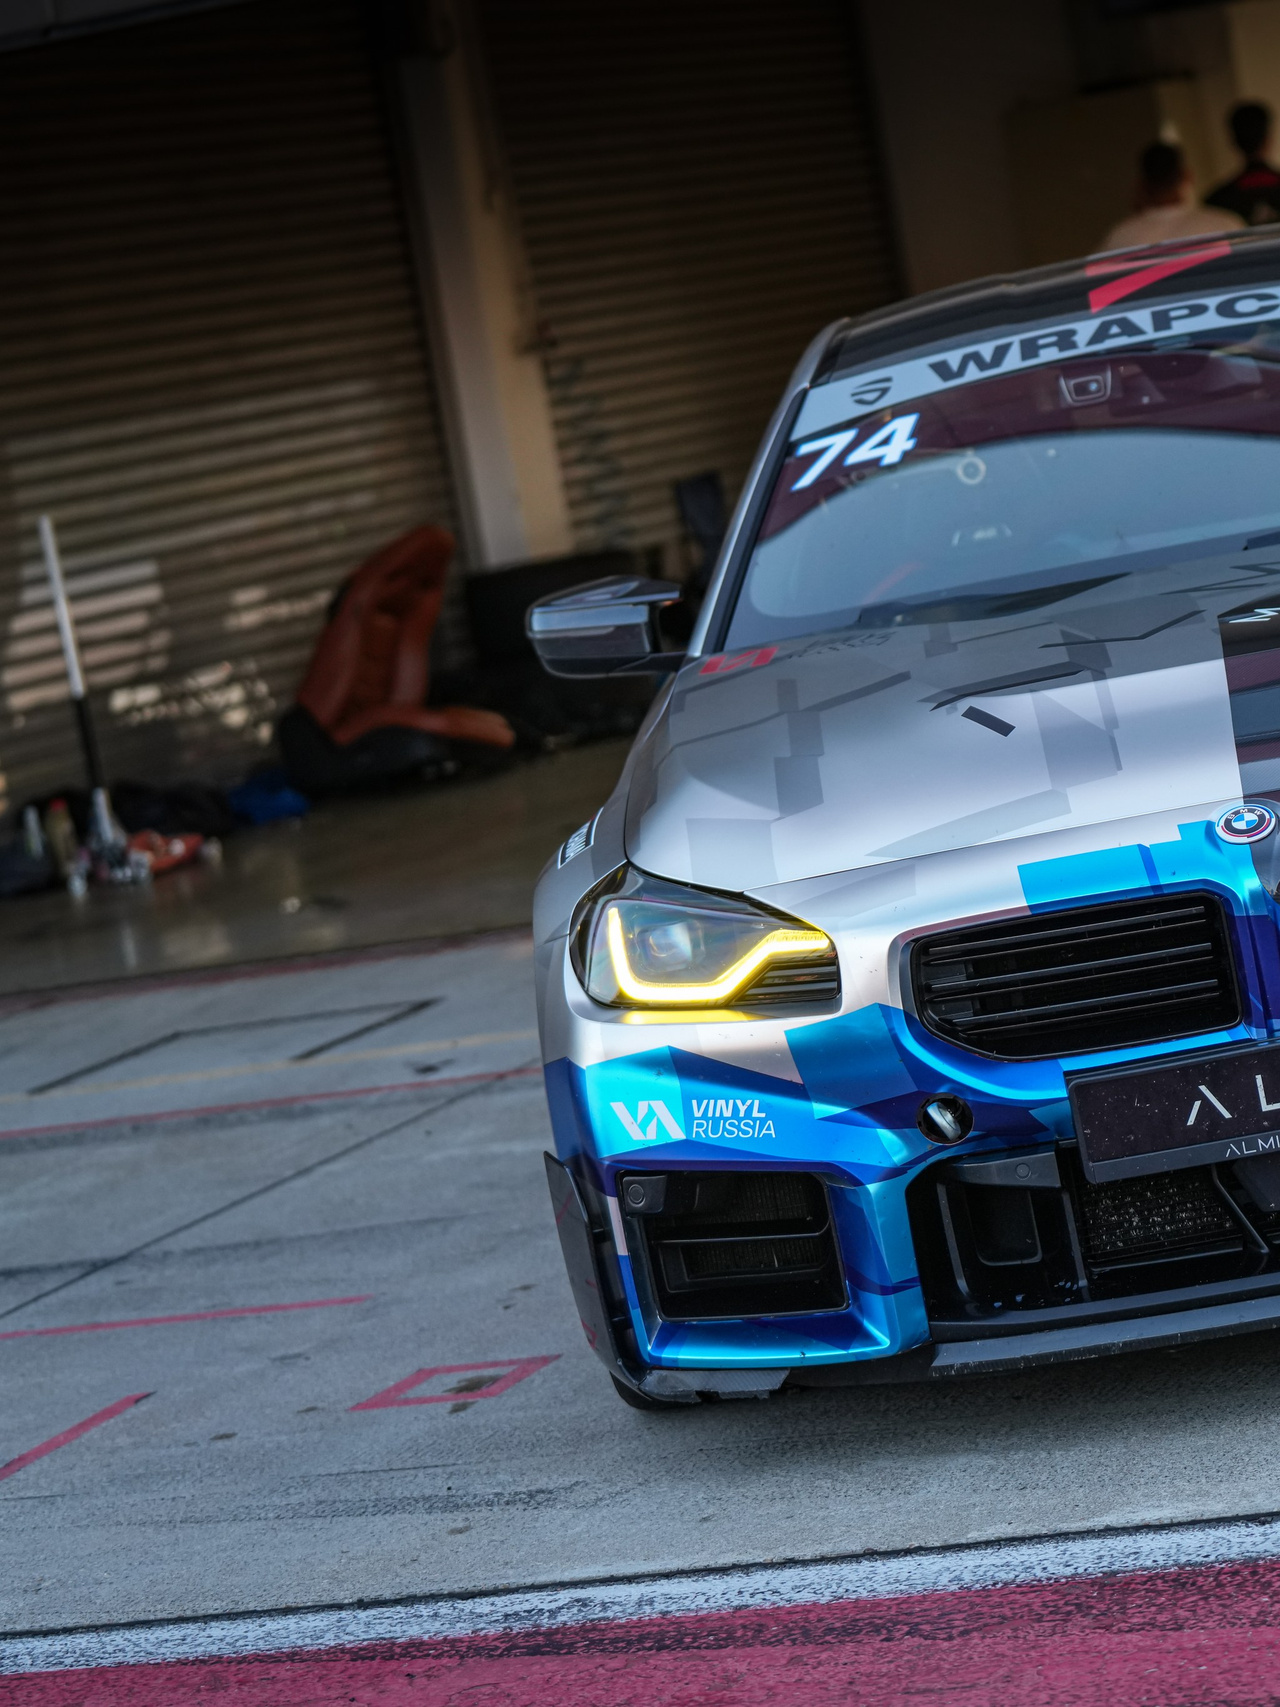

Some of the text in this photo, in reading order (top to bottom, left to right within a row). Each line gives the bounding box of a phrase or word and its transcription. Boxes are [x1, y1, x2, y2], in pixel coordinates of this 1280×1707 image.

[790, 413, 921, 491] 74
[691, 1099, 767, 1118] VINYL
[691, 1119, 777, 1139] RUSSIA
[1225, 1134, 1280, 1158] ALMI
